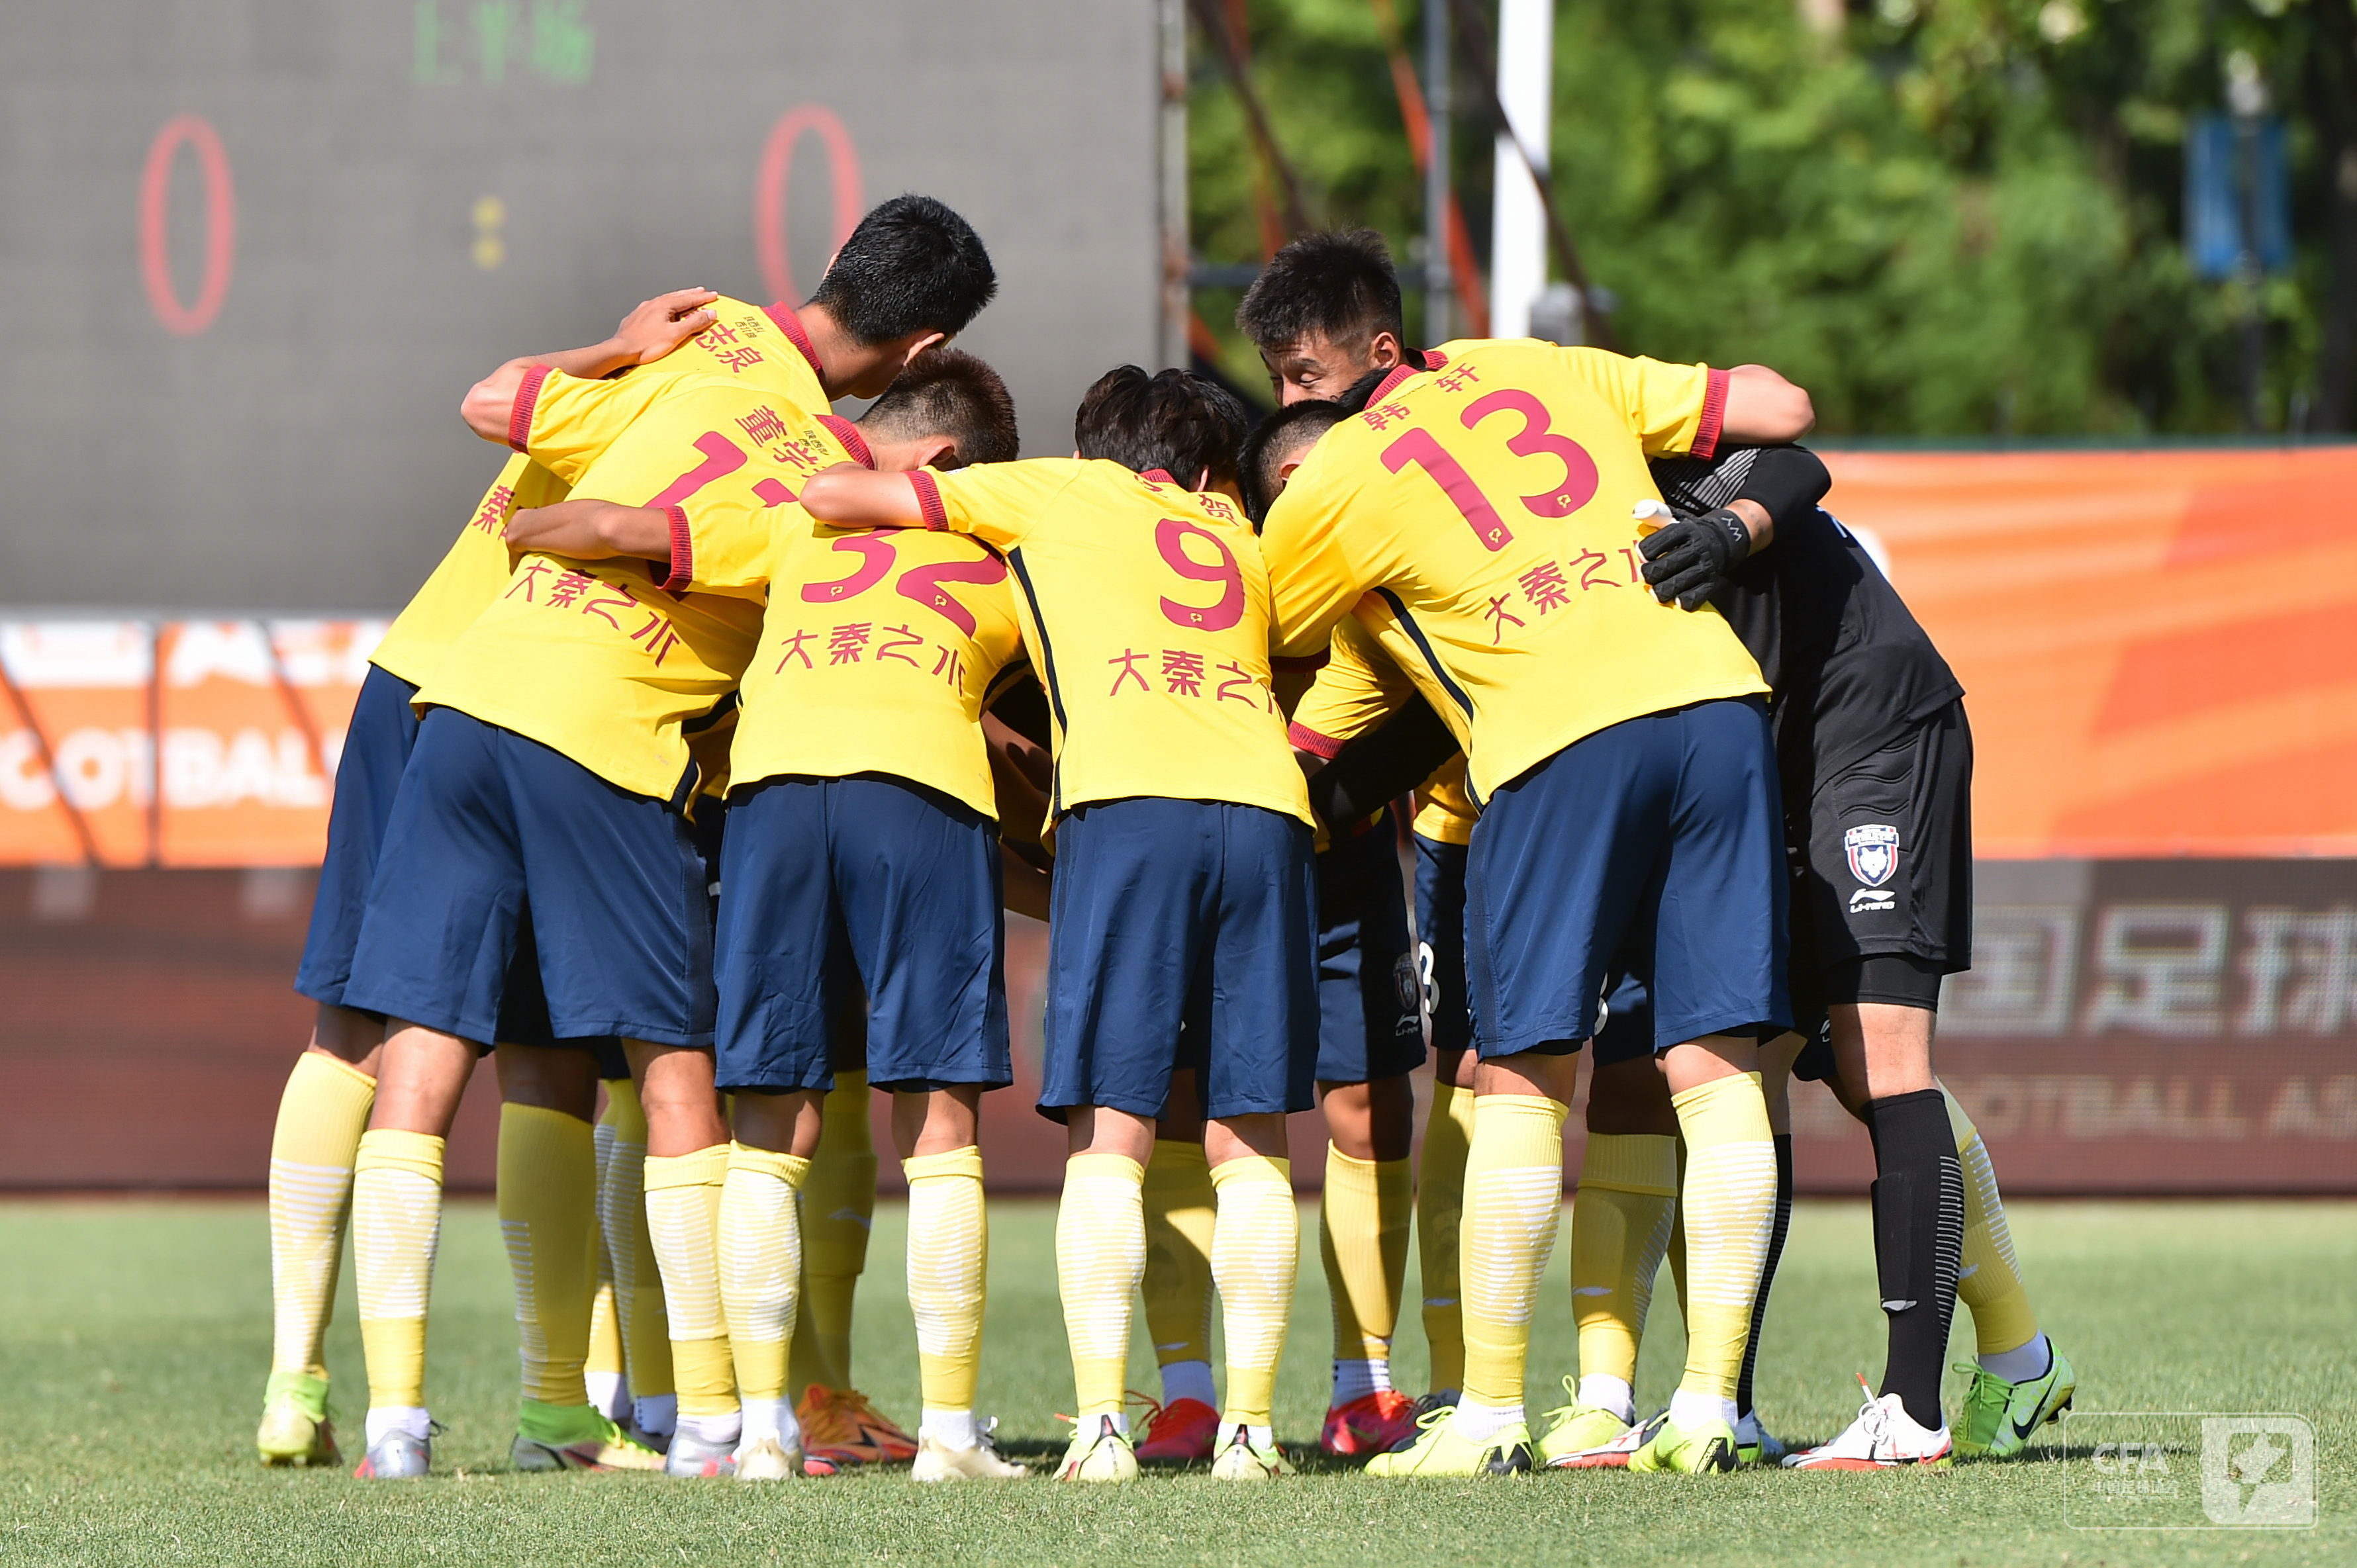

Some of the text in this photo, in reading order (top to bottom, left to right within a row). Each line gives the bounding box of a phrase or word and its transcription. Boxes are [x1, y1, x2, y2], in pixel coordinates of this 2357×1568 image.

[139, 111, 237, 339] 0
[679, 307, 764, 373] 志泉
[734, 404, 828, 479] 董学
[1380, 388, 1599, 552] 13
[505, 559, 681, 669] 大秦之水
[801, 528, 1008, 641] 32
[1155, 518, 1245, 631] 9
[775, 622, 967, 697] 大秦之水
